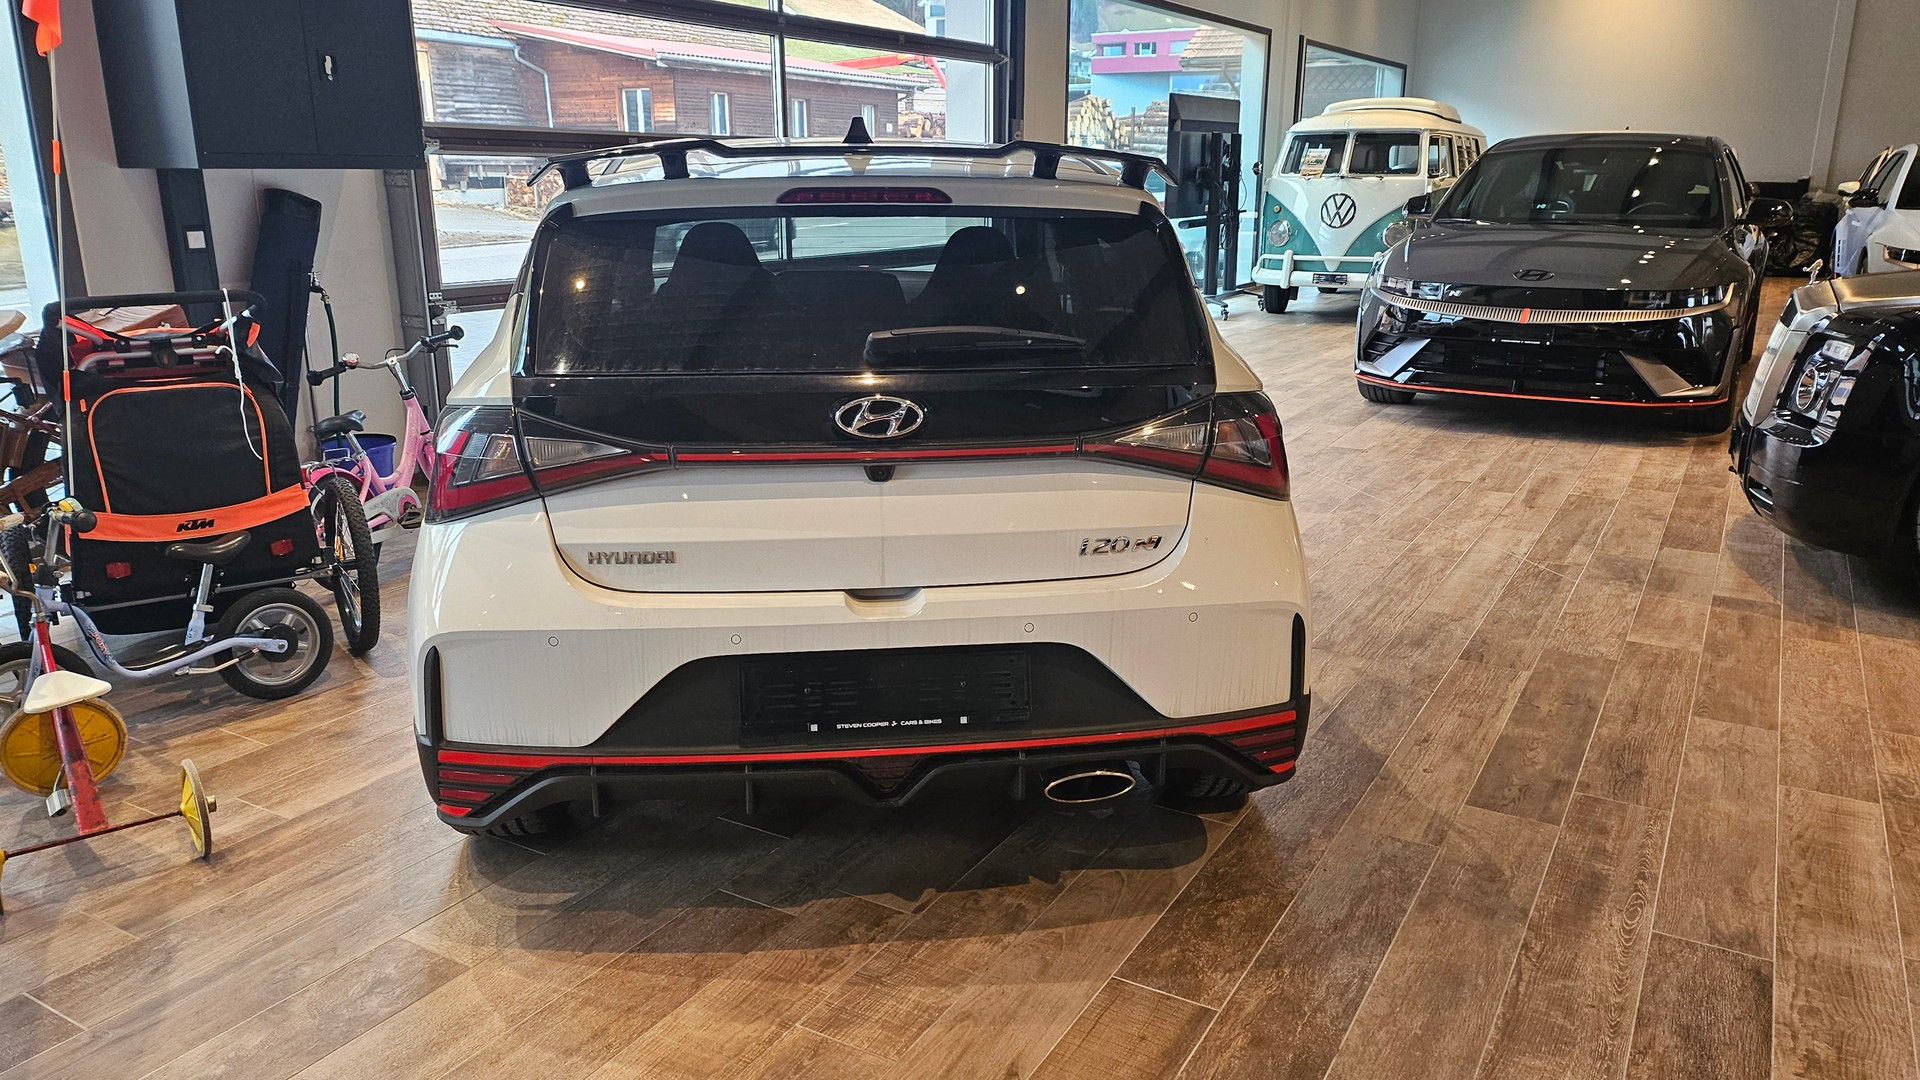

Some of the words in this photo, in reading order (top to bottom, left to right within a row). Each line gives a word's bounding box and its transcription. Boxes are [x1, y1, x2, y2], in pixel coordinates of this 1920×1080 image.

[1321, 193, 1356, 228] VW
[176, 518, 215, 532] KTM
[588, 550, 676, 564] HYUNDAI
